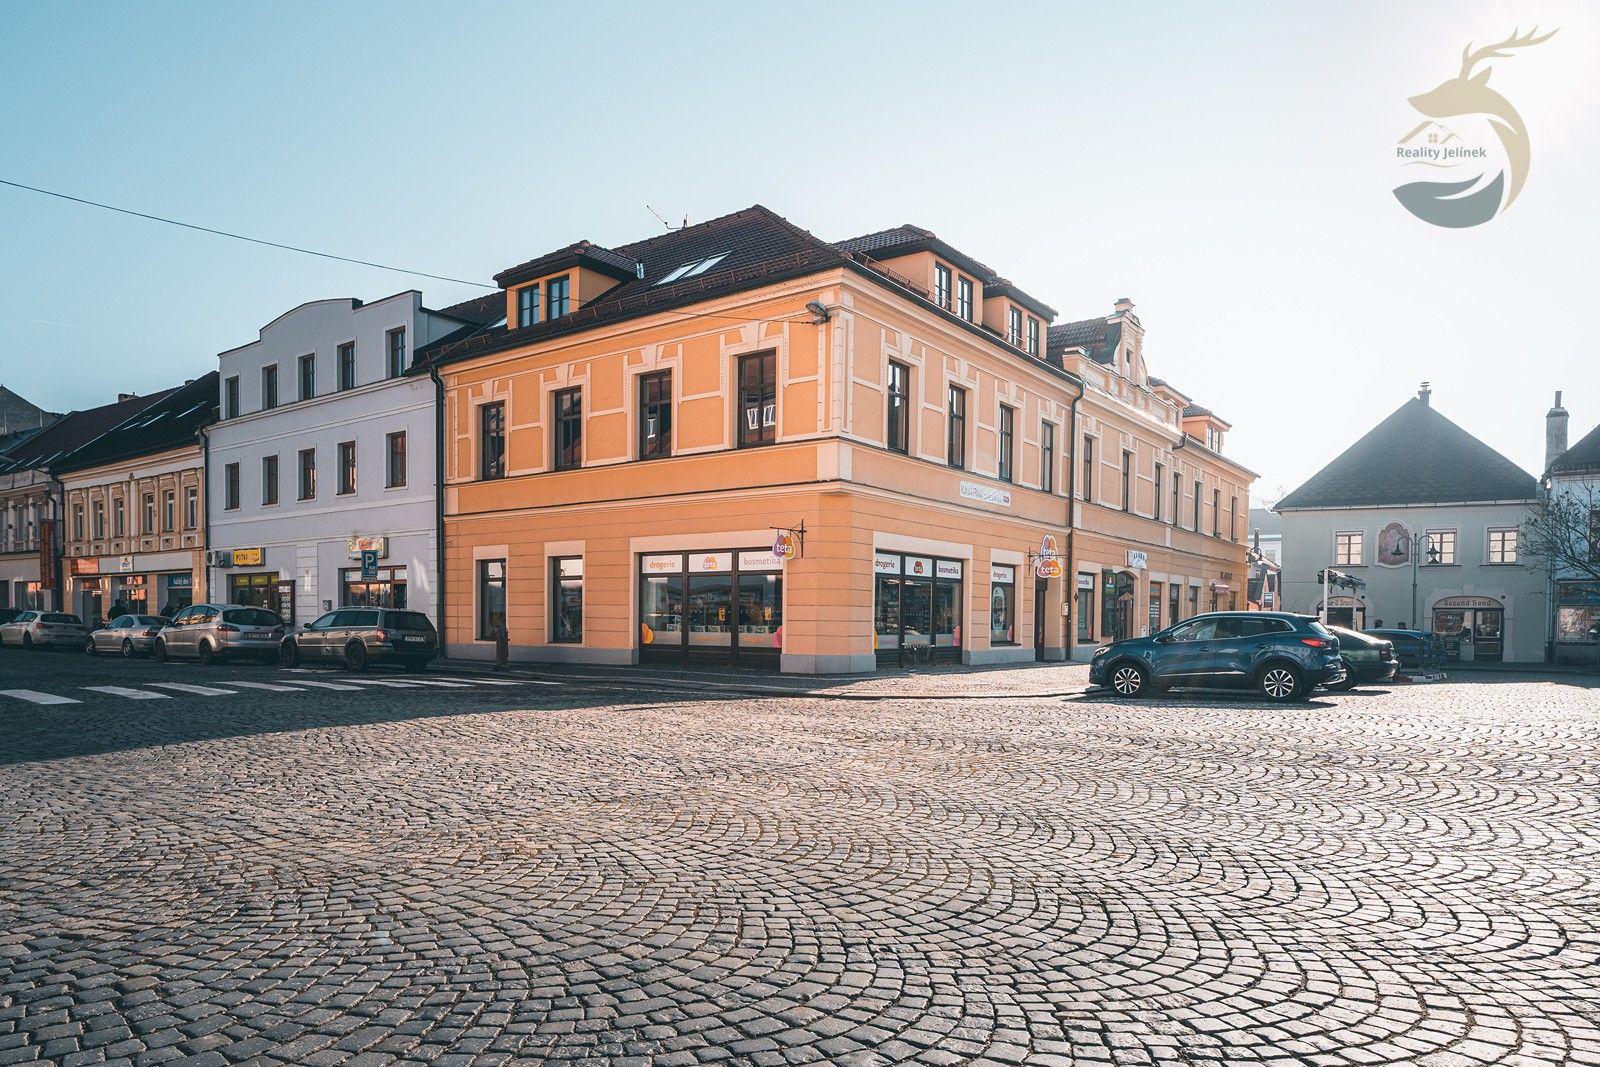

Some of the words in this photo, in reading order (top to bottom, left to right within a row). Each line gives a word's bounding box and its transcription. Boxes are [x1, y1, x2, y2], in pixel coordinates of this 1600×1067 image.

[776, 543, 792, 553] teta
[365, 553, 374, 568] P
[650, 560, 675, 570] drogerie
[743, 557, 781, 566] kosmetika
[875, 558, 895, 569] drogerie
[938, 565, 959, 574] kosmetika
[1041, 566, 1059, 574] teta
